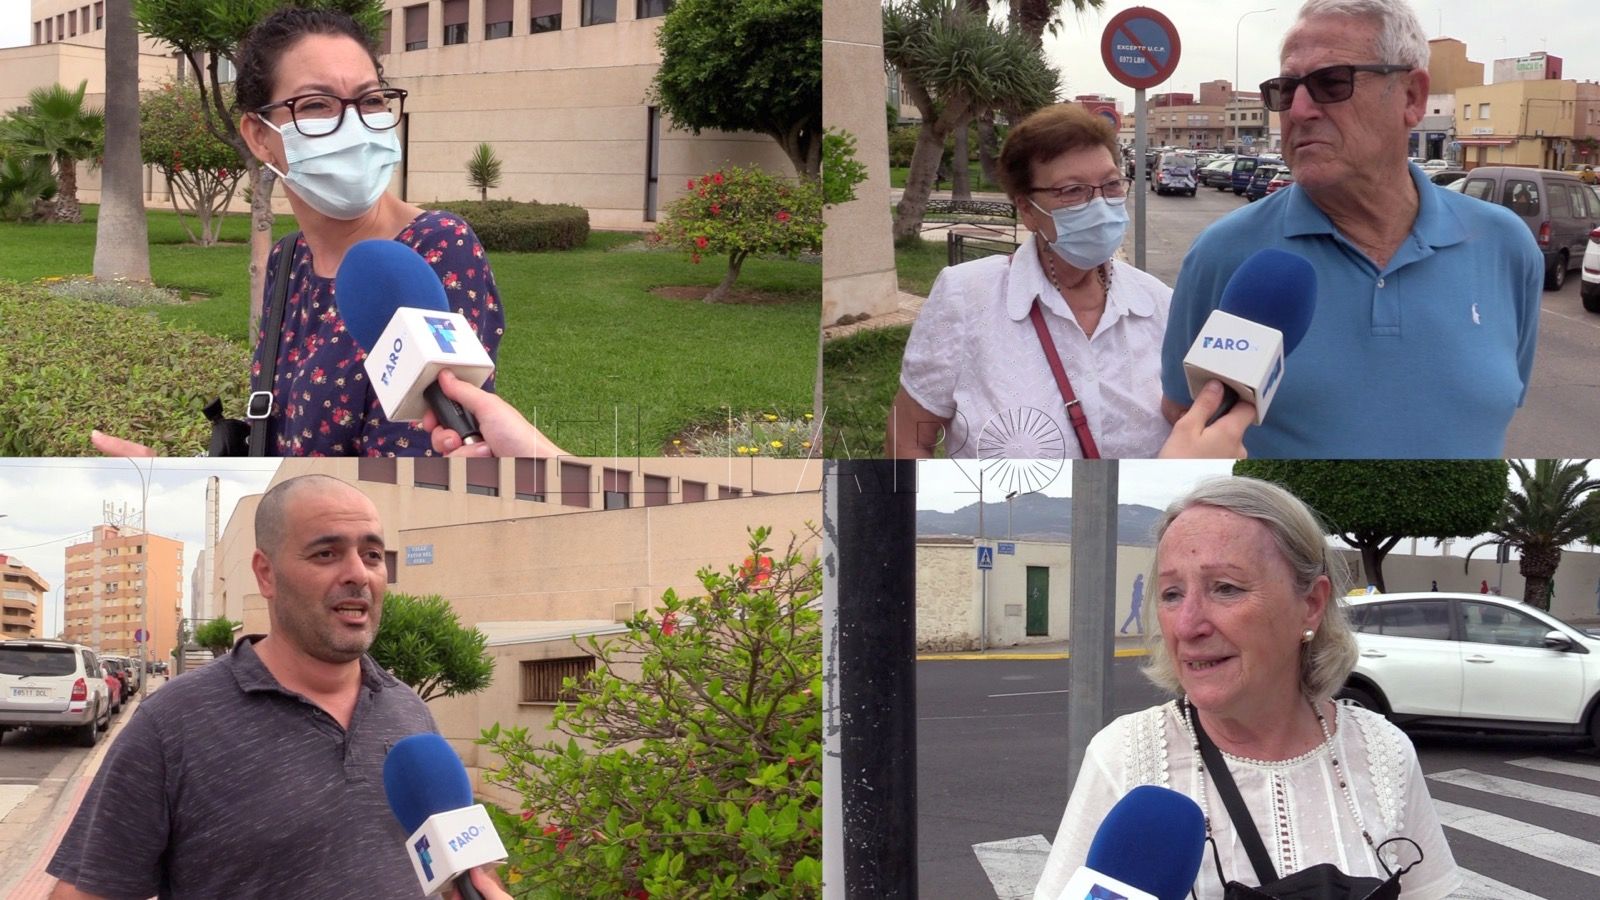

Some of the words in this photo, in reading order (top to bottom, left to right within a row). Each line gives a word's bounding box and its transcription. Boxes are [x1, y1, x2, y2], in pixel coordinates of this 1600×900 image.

[1203, 336, 1250, 351] FARO
[380, 337, 403, 386] FARO
[448, 825, 480, 853] FARO
